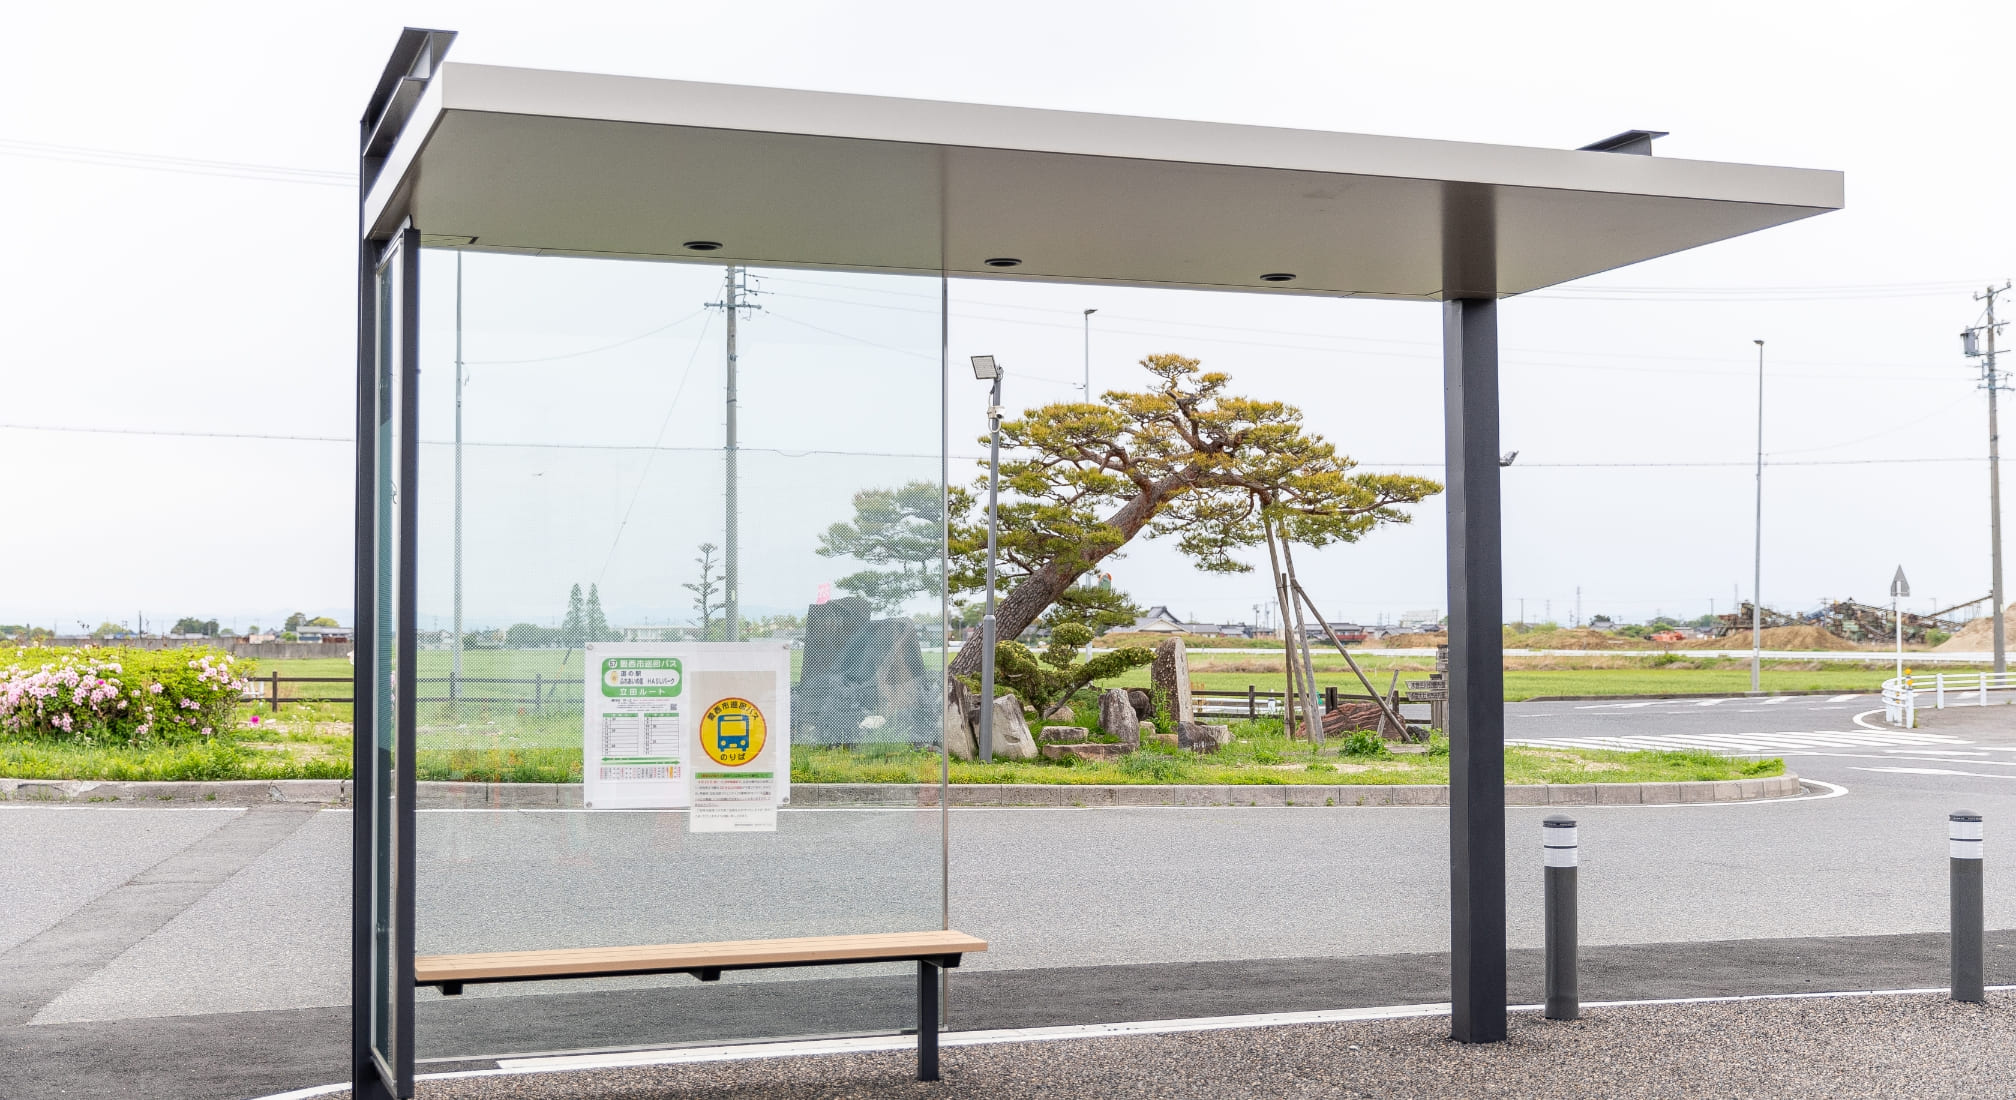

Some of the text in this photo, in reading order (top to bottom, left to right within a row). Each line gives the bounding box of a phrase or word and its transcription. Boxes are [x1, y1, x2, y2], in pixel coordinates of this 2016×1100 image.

[620, 688, 665, 696] 立田ルート
[720, 753, 746, 761] のりば
